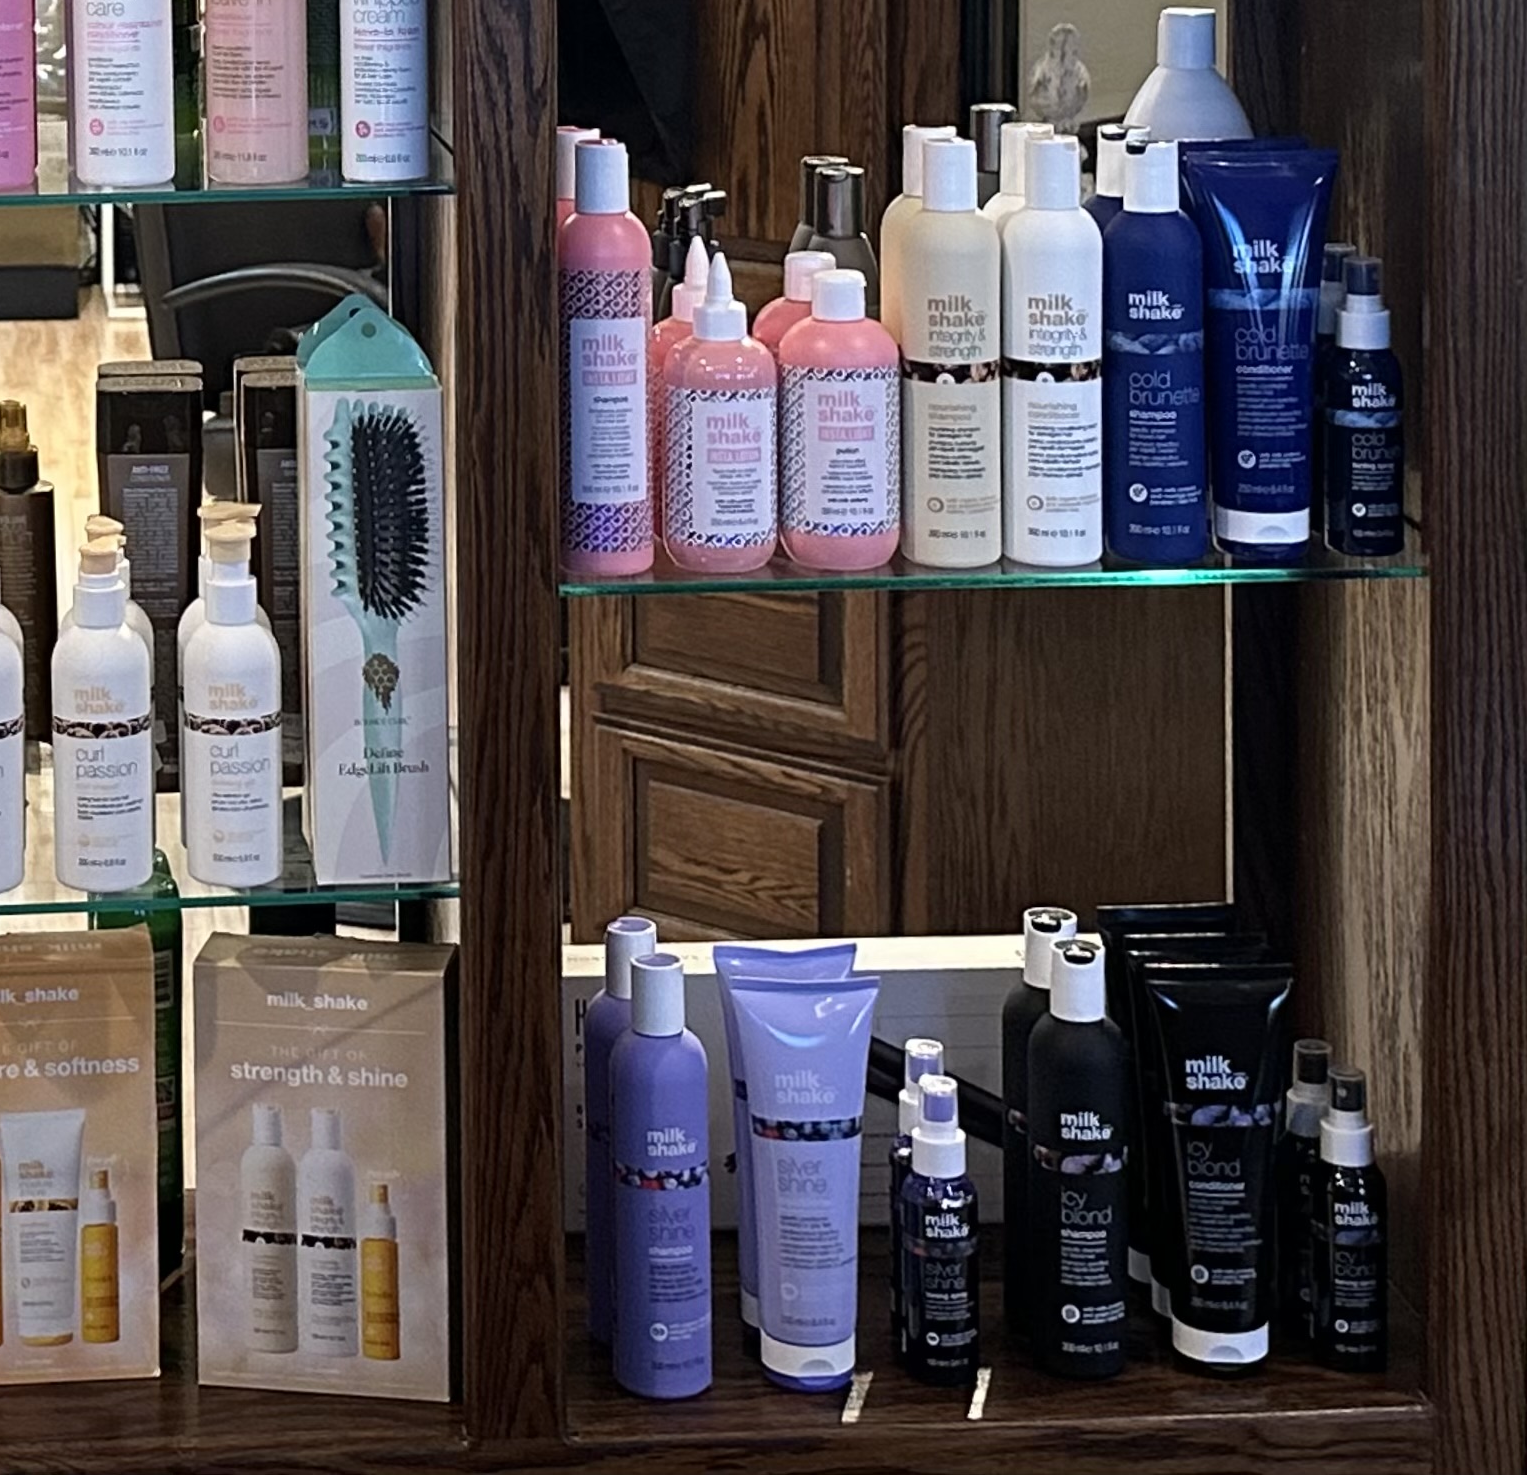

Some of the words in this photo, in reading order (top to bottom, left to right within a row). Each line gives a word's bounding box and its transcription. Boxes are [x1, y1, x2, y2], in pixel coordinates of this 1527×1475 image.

[86, 1, 125, 17] care
[353, 8, 406, 23] cream
[928, 312, 985, 327] shake
[1028, 311, 1086, 326] shake
[1129, 306, 1182, 320] shake
[928, 329, 975, 344] integrity
[582, 351, 637, 366] shake
[928, 344, 982, 359] strength
[1029, 344, 1083, 358] strength
[1129, 372, 1171, 388] cold
[1129, 386, 1200, 405] brunette
[1352, 396, 1395, 408] shake
[818, 408, 873, 422] shake
[1129, 411, 1177, 420] shampoo
[707, 430, 762, 445] shake
[75, 746, 105, 763] curl
[210, 743, 239, 759] curl
[363, 747, 404, 760] Define
[76, 761, 138, 779] passion
[210, 758, 270, 776] passion
[393, 762, 429, 775] Brush
[267, 992, 368, 1012] milk_shake
[24, 1061, 40, 1078] &
[43, 1055, 140, 1077] softness
[230, 1063, 324, 1086] strength
[328, 1067, 343, 1085] &
[348, 1068, 408, 1088] shine
[1186, 1073, 1246, 1090] shake
[776, 1088, 835, 1104] shake
[1061, 1126, 1112, 1140] shake
[647, 1142, 696, 1156] shake
[1188, 1142, 1212, 1160] icy
[778, 1158, 823, 1177] silver
[1188, 1159, 1241, 1177] blond
[778, 1176, 827, 1195] shine
[1061, 1189, 1087, 1208] icy
[1061, 1206, 1112, 1224] blond
[926, 1225, 970, 1239] shake
[1061, 1229, 1106, 1240] shampoo
